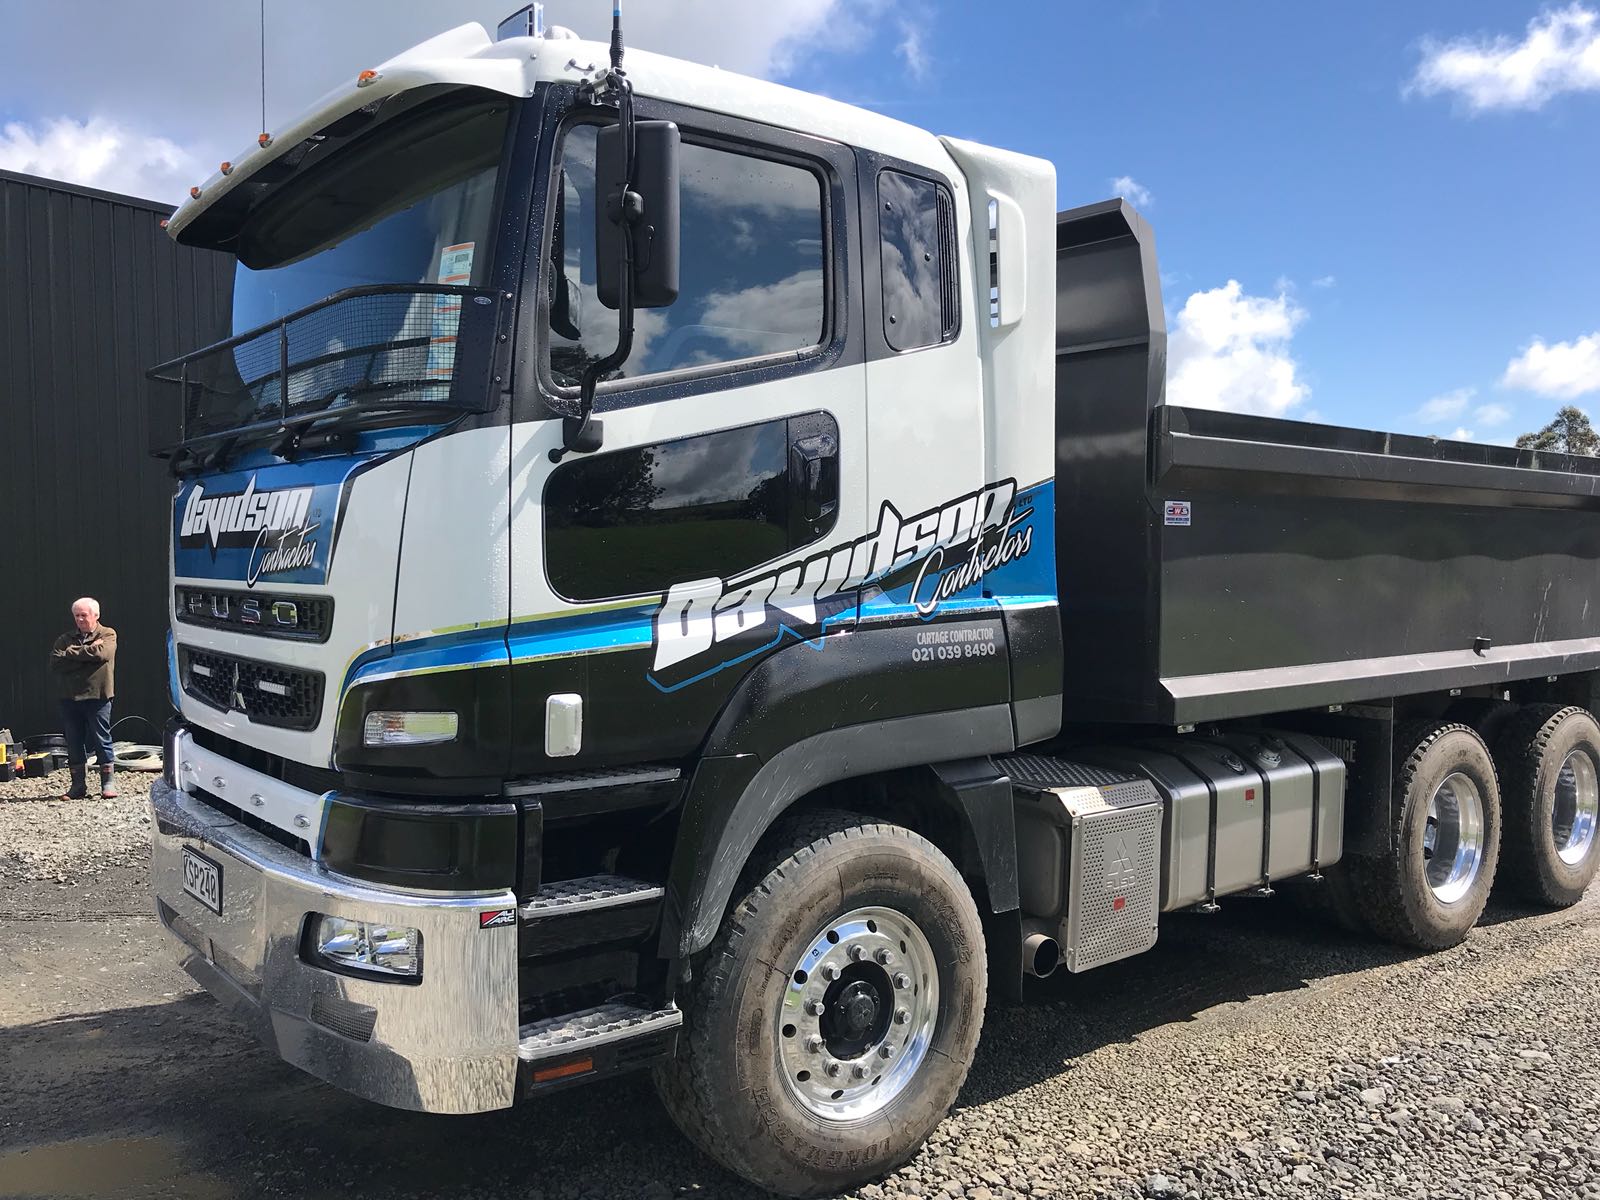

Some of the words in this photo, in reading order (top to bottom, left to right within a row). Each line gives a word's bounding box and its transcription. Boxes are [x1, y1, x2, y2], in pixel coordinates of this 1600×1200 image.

[1018, 495, 1033, 508] LTD
[247, 515, 321, 585] Contractors
[910, 505, 1034, 614] Contractors
[188, 594, 299, 628] FUSO
[917, 631, 949, 645] CARTAGE
[949, 627, 994, 643] CONTRACTOR
[912, 647, 935, 662] 021
[937, 645, 962, 660] 039
[964, 642, 996, 658] 8490
